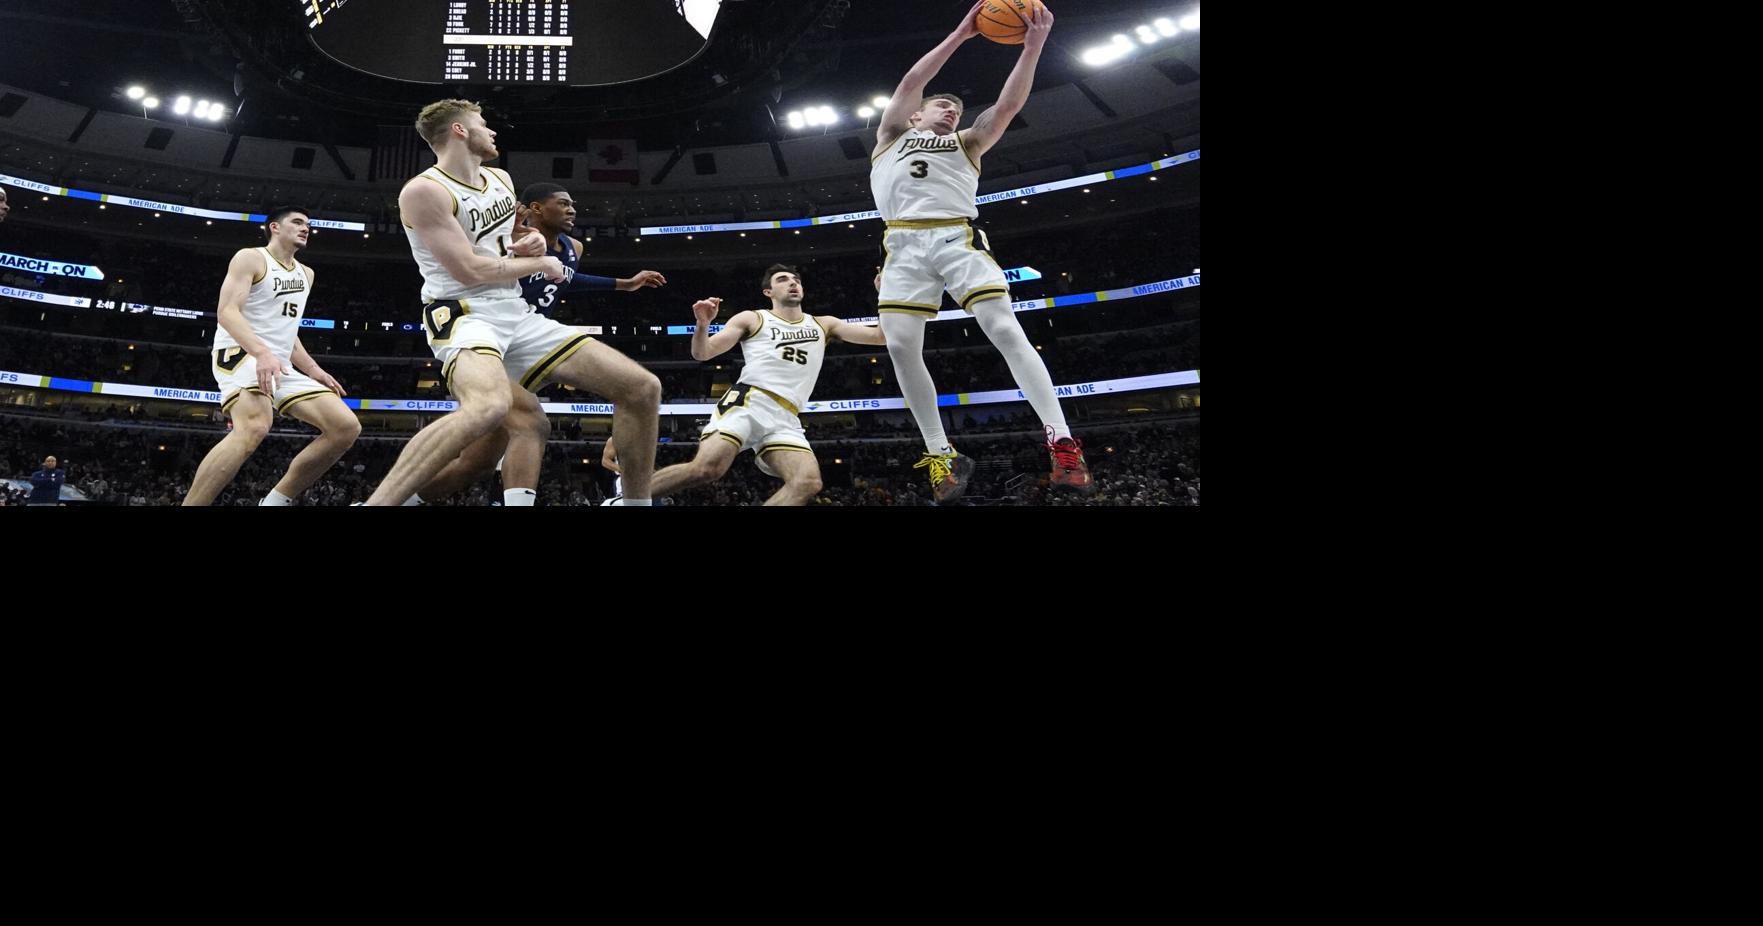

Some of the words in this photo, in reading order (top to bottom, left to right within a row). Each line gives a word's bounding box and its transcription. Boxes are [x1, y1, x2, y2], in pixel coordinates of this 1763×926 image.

[909, 160, 929, 178] 3
[13, 179, 51, 192] CLIFFS
[974, 190, 1017, 204] AMERICAN
[128, 199, 168, 211] AMERICAN
[469, 196, 516, 232] Purdue
[844, 211, 881, 220] CLIFFS
[309, 220, 345, 228] CLIFFS
[273, 276, 305, 291] Purdue
[1132, 279, 1184, 296] AMERICAN
[2, 287, 45, 301] CLIFFS
[538, 284, 558, 307] 3
[281, 301, 298, 318] 15
[770, 328, 820, 341] Purdue
[782, 346, 808, 365] 25
[154, 388, 201, 399] AMERICAN
[406, 401, 454, 409] CLIFFS
[830, 400, 881, 409] CLIFFS
